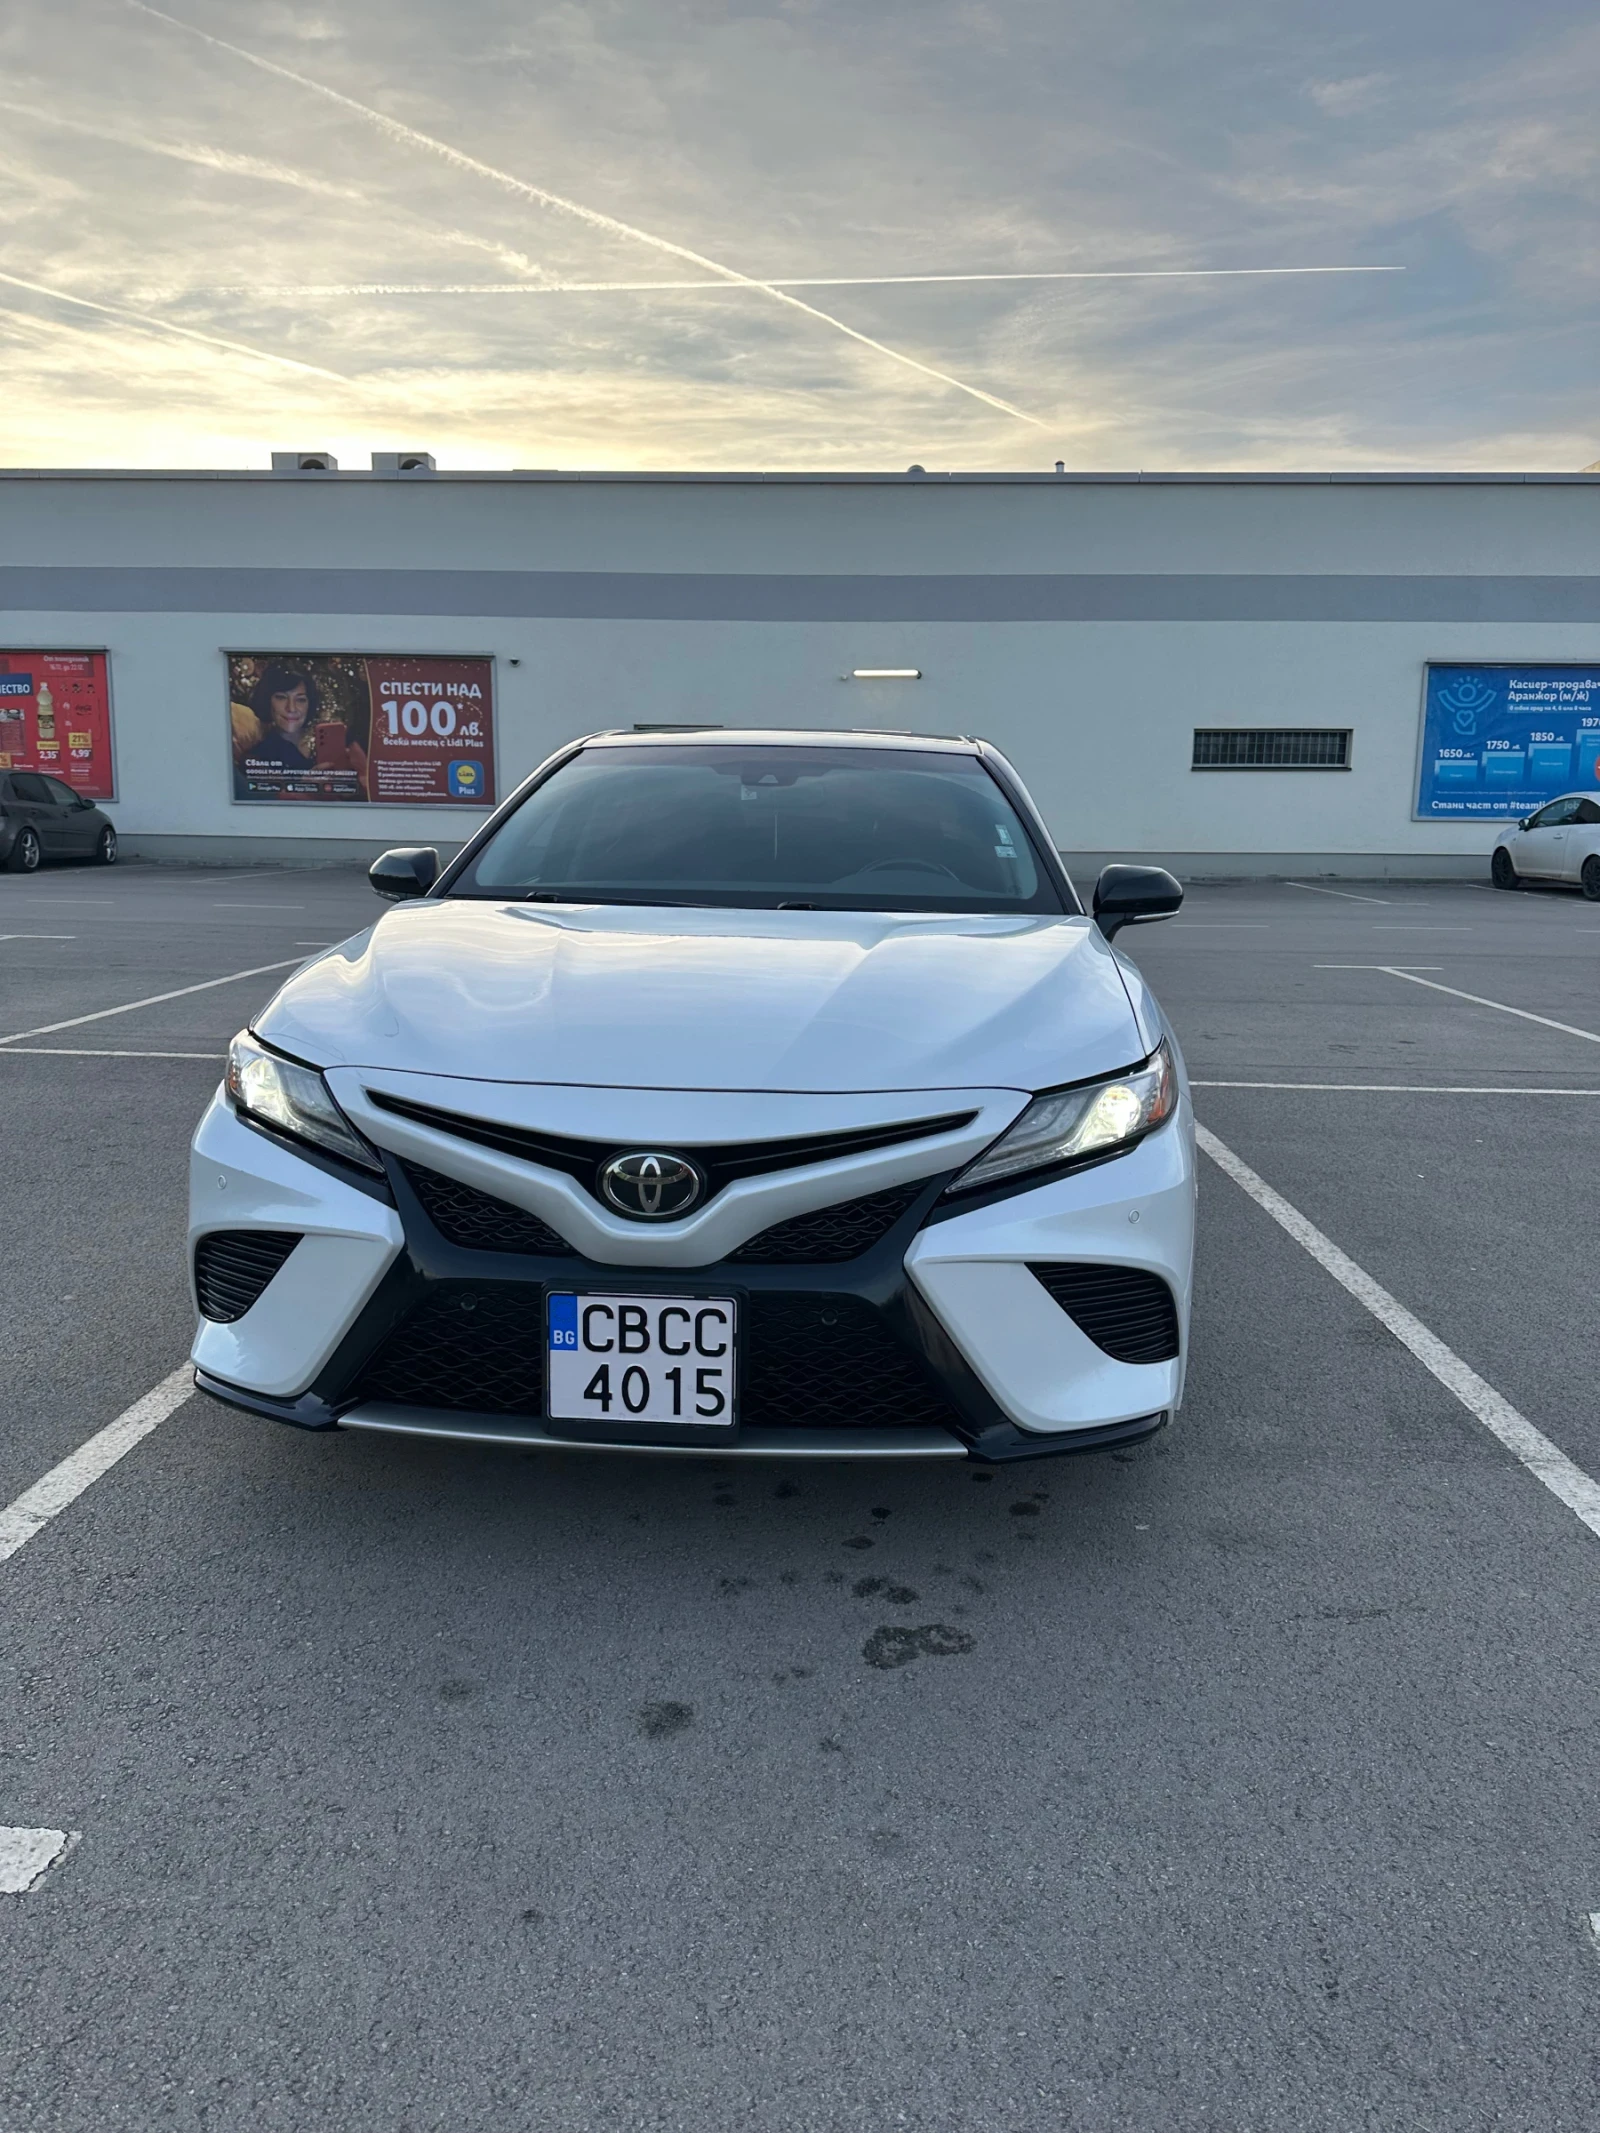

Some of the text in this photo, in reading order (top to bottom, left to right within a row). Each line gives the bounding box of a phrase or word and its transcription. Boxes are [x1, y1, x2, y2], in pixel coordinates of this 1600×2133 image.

[0, 683, 31, 694] ЕСТВО
[380, 681, 482, 699] СПЕСТИ НАД
[1508, 690, 1589, 702] Аранжор (м/ж)
[1581, 717, 1600, 727] 197
[460, 721, 484, 737] лв.
[1530, 732, 1555, 742] 1850
[383, 737, 409, 746] всеки
[411, 739, 439, 749] месец
[447, 738, 463, 747] Lidl
[465, 739, 484, 748] Plus
[1486, 740, 1510, 750] 1750
[1439, 748, 1463, 758] 1650
[246, 758, 269, 766] Свали
[458, 786, 475, 795] Plus
[1432, 800, 1465, 810] Стани
[1466, 801, 1491, 810] част
[1493, 802, 1508, 810] от
[553, 1330, 575, 1345] BG
